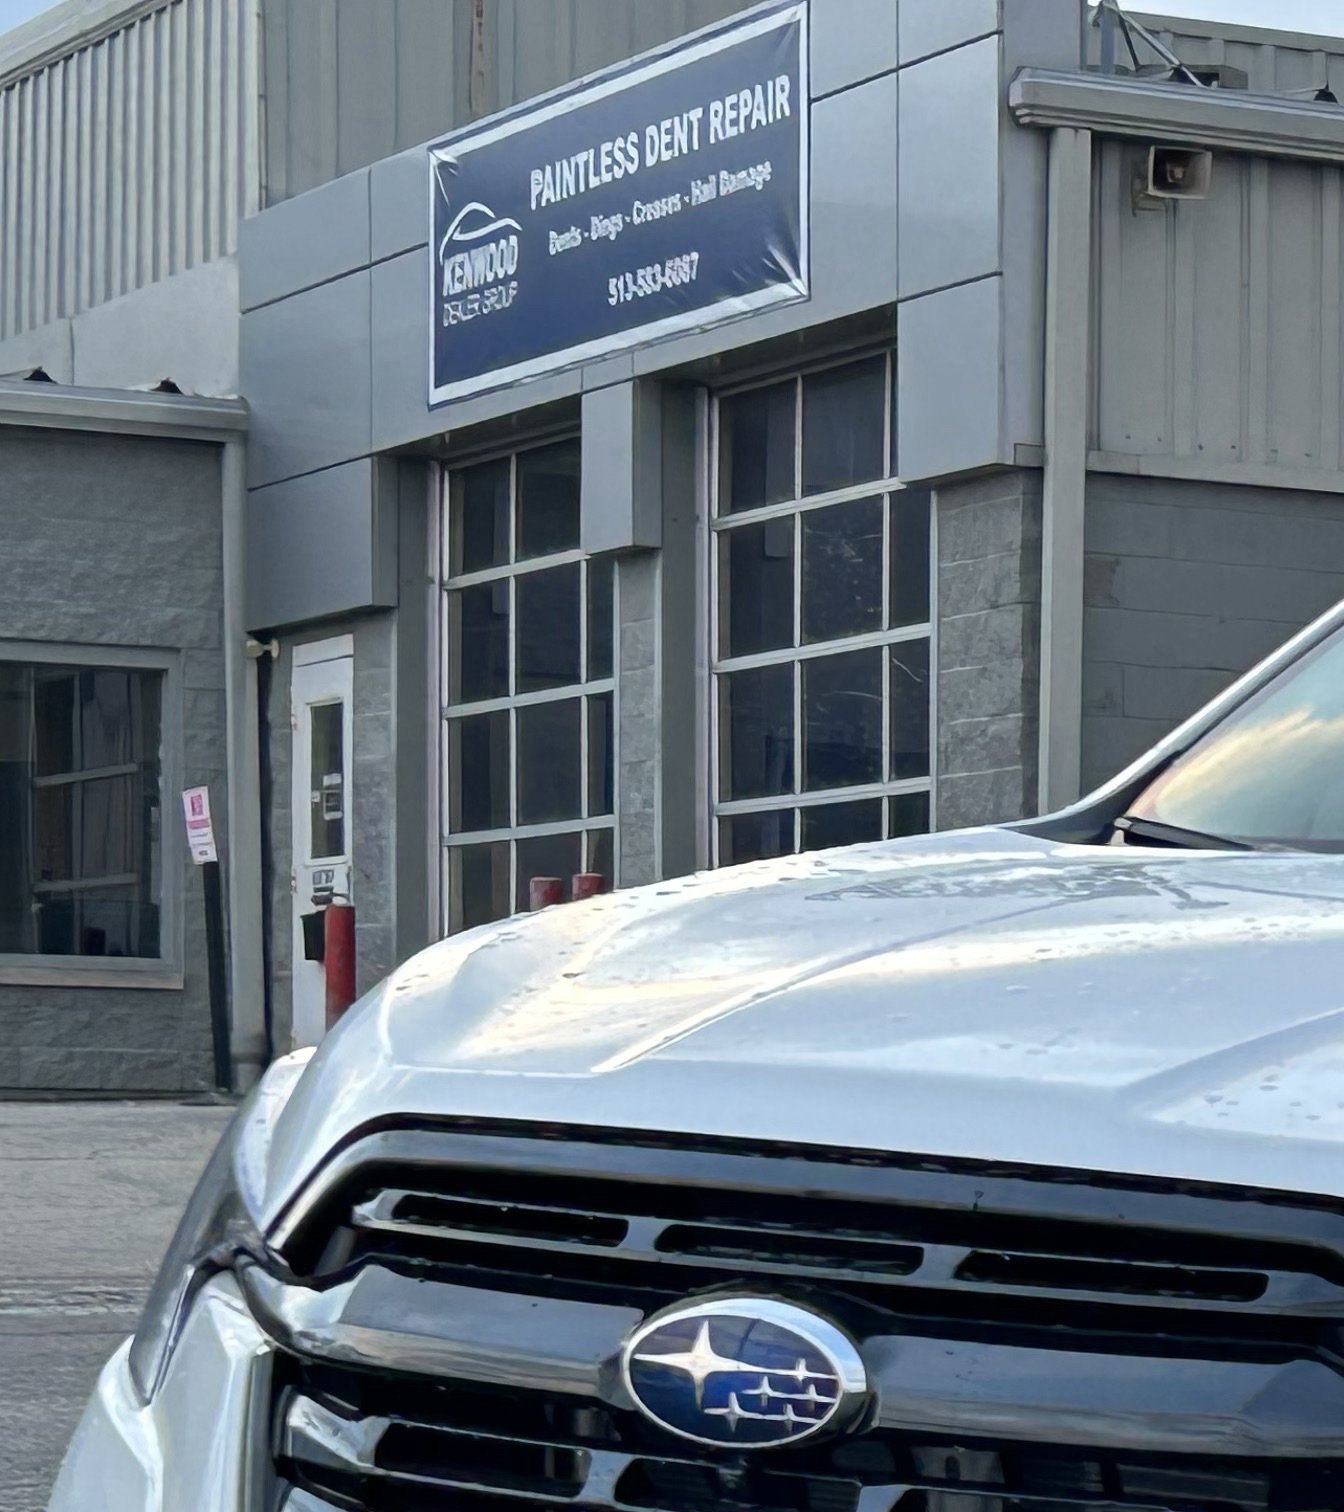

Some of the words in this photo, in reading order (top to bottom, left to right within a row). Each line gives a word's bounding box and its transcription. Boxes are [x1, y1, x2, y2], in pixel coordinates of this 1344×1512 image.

[530, 131, 640, 211] PAINTLESS
[645, 107, 703, 168] DENT
[709, 74, 791, 145] REPAIR
[590, 213, 624, 241] Dings
[690, 174, 717, 206] Hail
[719, 161, 772, 197] Damage
[442, 234, 519, 297] KENWOOD
